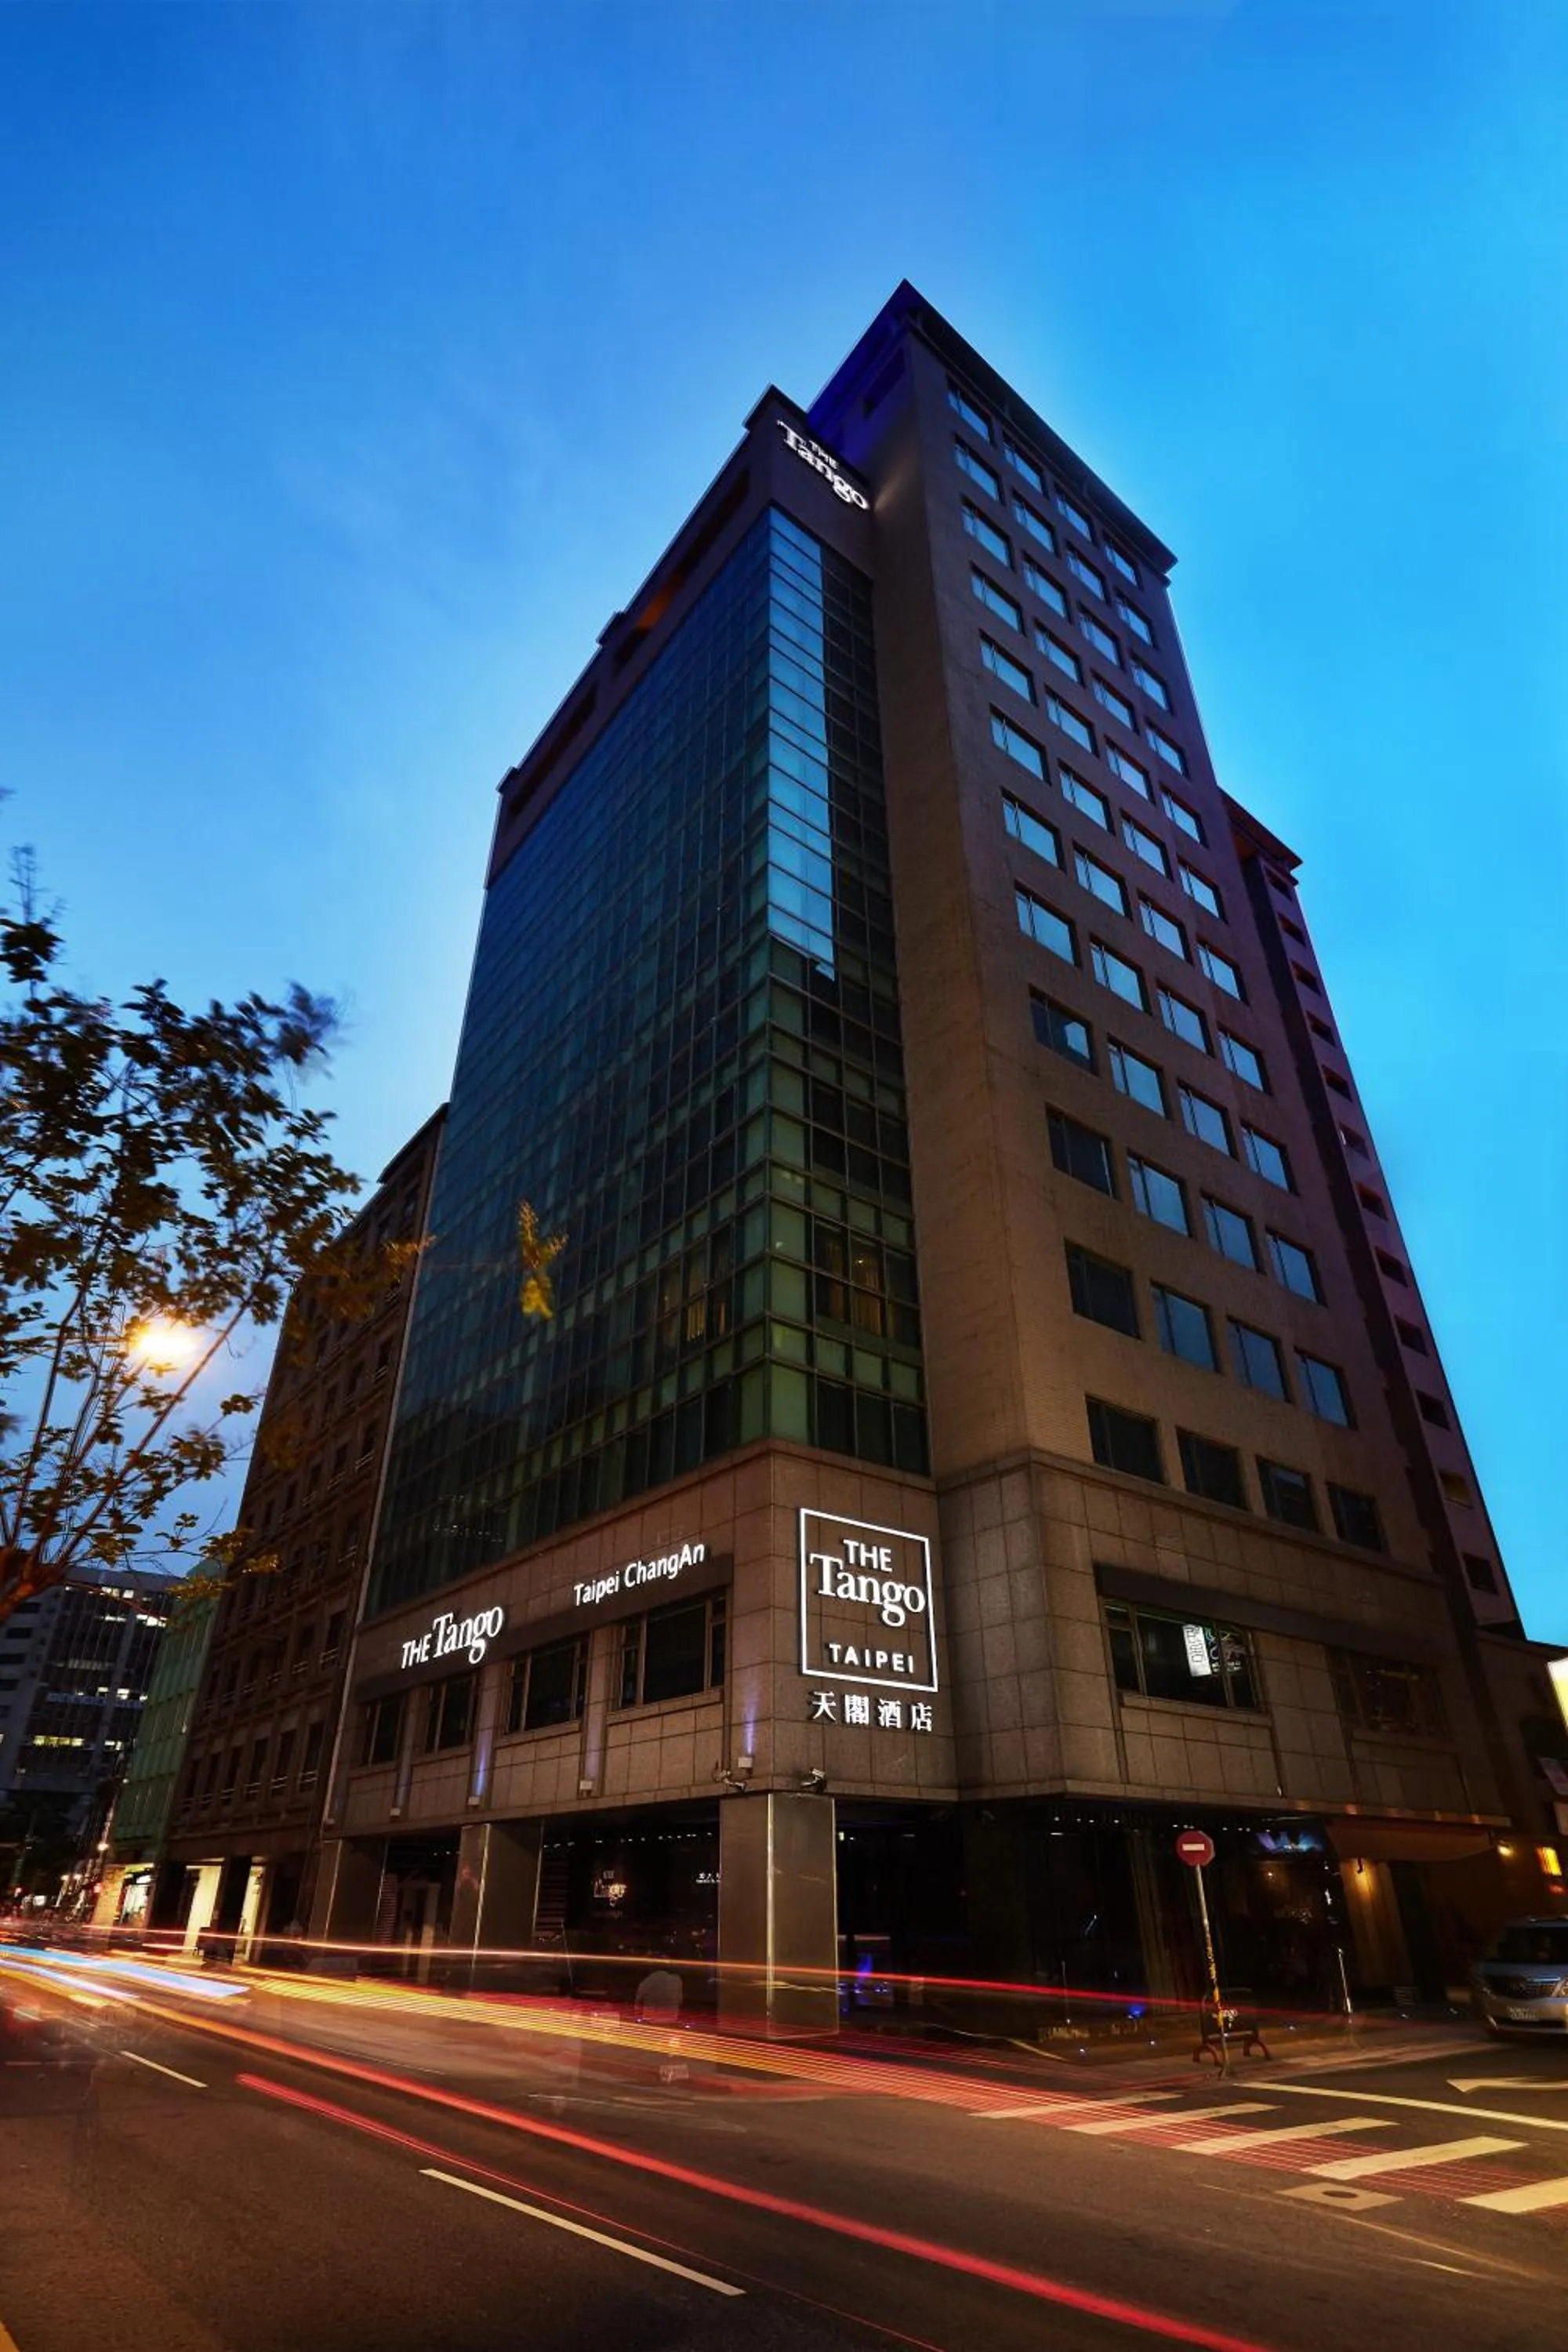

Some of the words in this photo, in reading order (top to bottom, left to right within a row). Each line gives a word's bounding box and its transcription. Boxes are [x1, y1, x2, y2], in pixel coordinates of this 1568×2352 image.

[777, 419, 869, 510] Tango
[809, 441, 839, 470] THE
[573, 1571, 620, 1606] Taipei
[624, 1543, 705, 1587] ChangAn
[843, 1539, 892, 1572] THE
[809, 1553, 926, 1627] Tango
[401, 1633, 432, 1668] THE
[432, 1606, 503, 1664] Tango
[829, 1642, 914, 1674] TAIPEI
[811, 1690, 933, 1732] 天閣酒店
